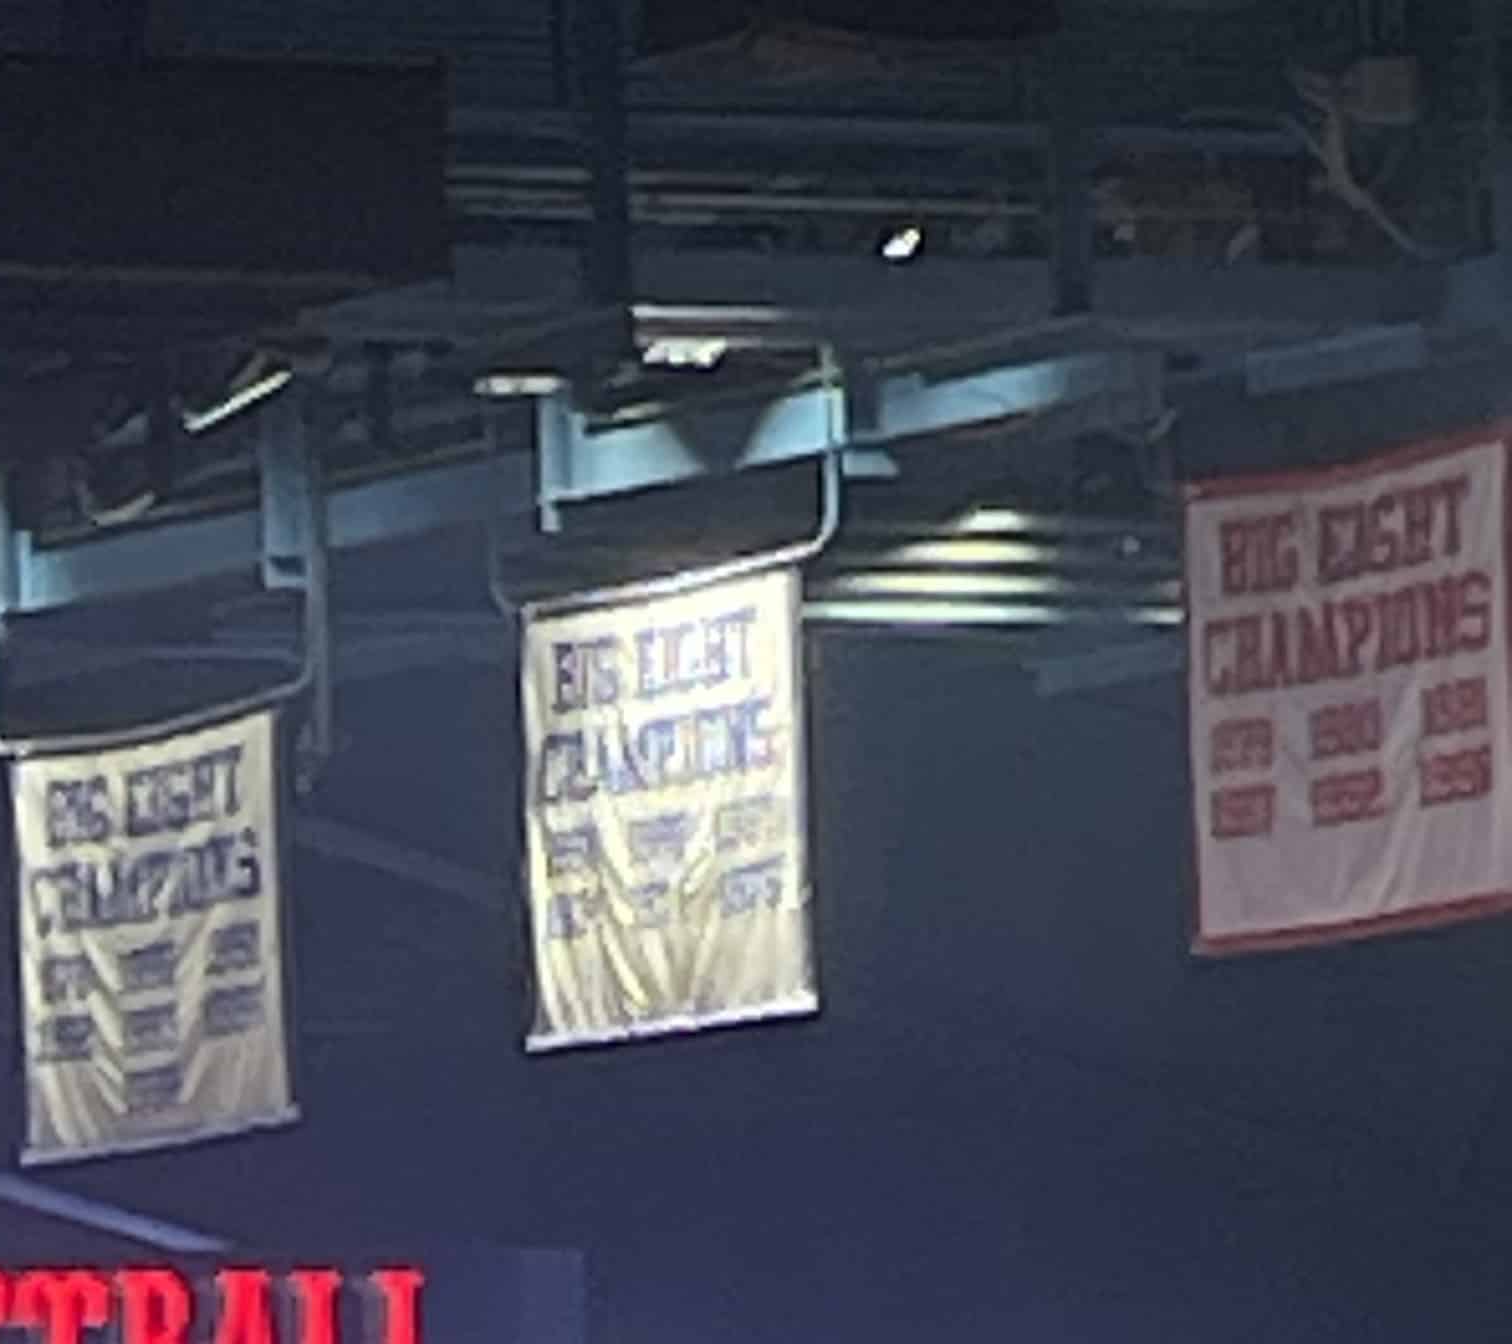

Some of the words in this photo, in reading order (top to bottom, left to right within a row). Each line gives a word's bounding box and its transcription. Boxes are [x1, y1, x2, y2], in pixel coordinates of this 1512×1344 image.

[1220, 511, 1299, 596] BIG
[1317, 477, 1469, 585] EIGHT
[1201, 570, 1489, 696] CHAMPIONS
